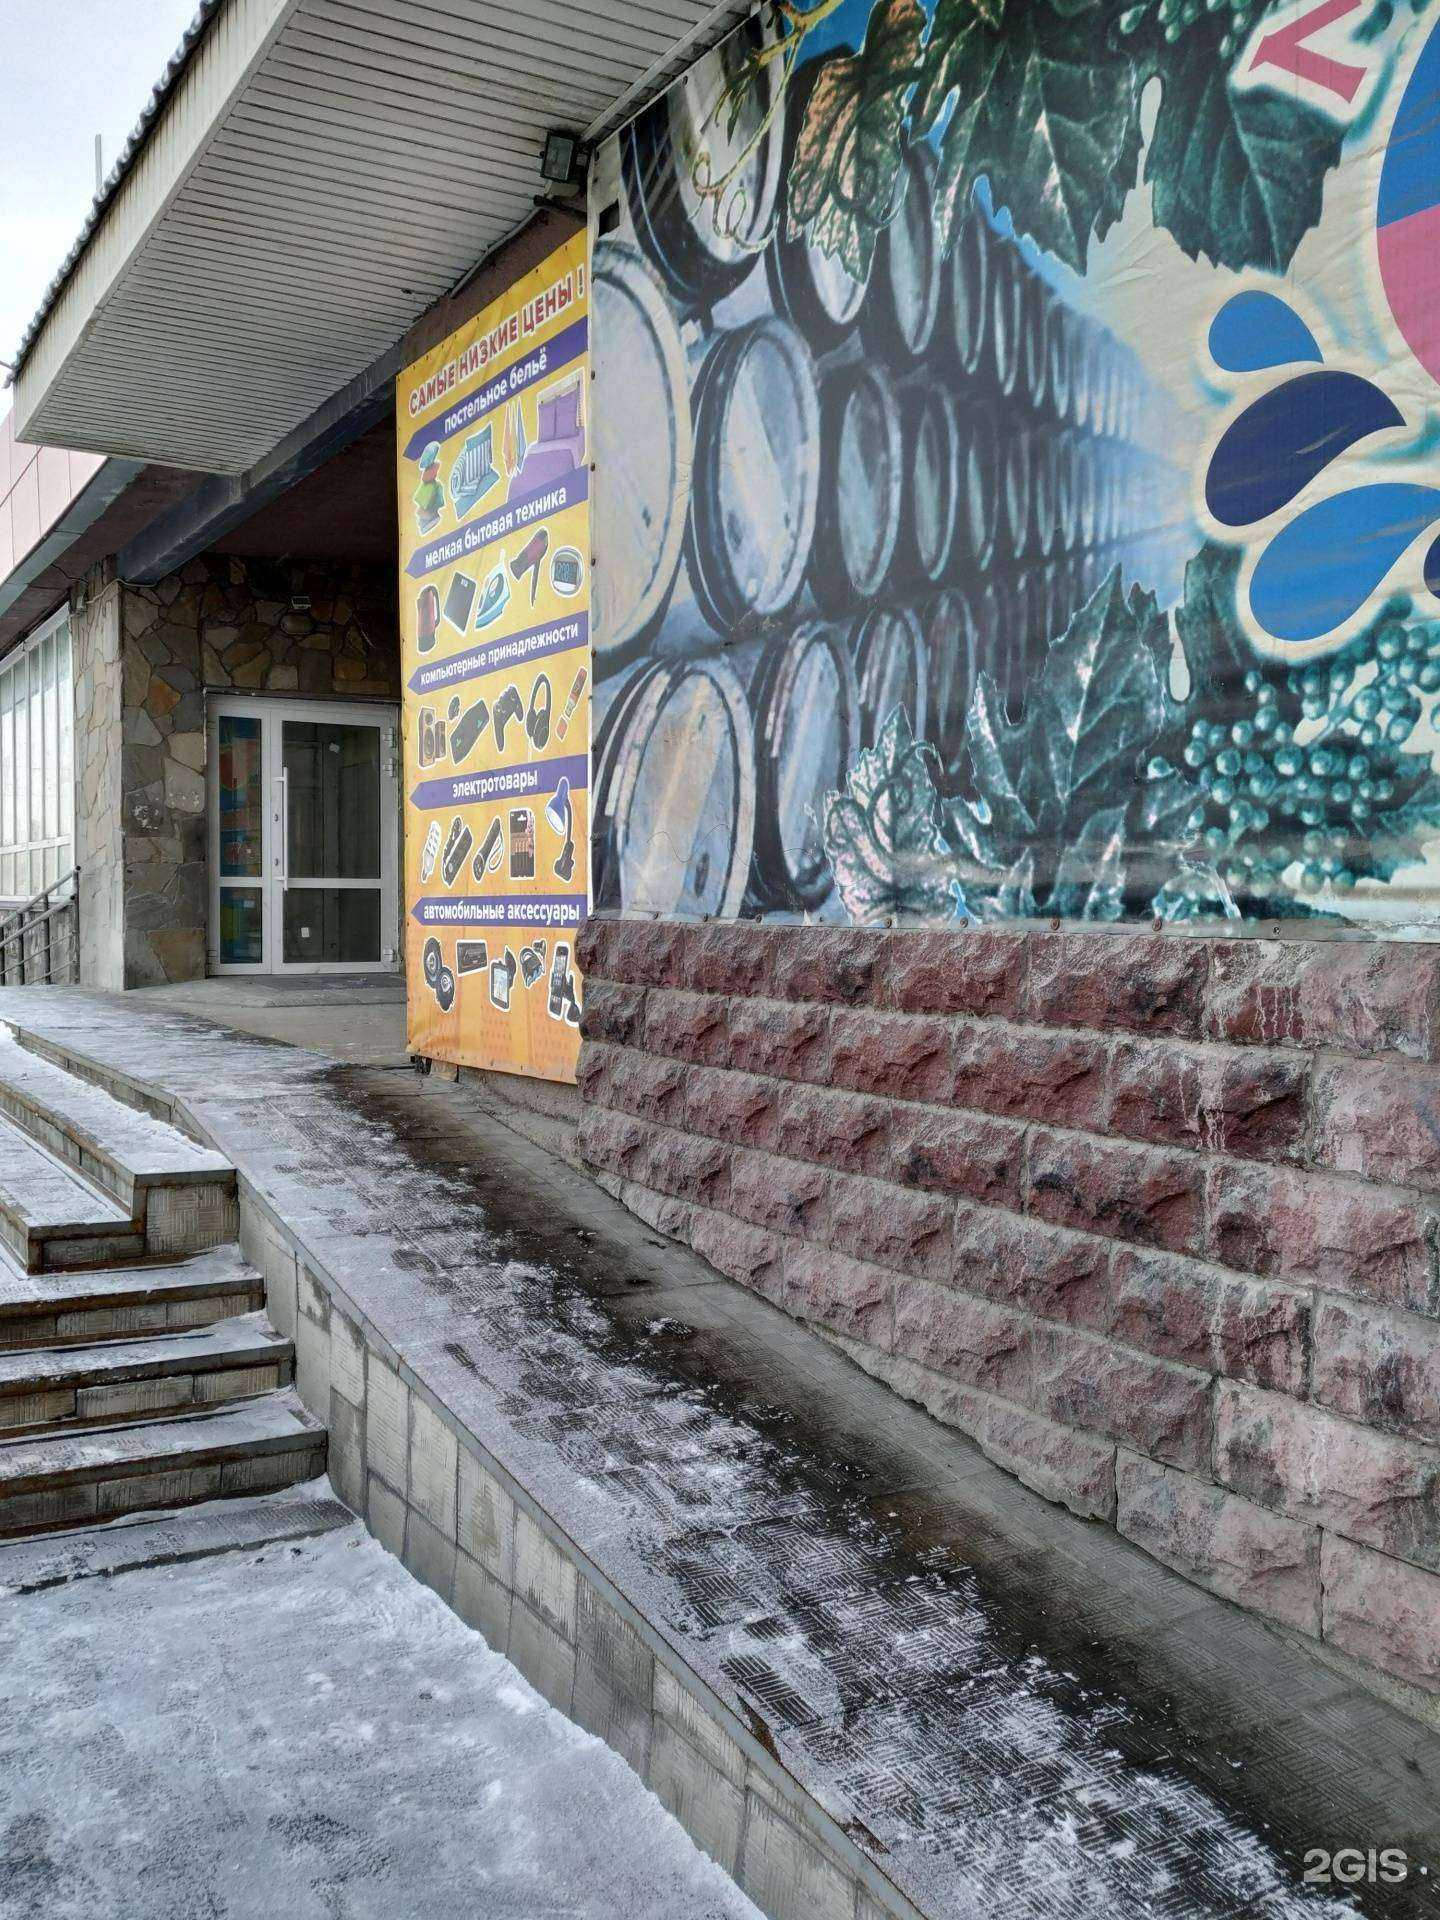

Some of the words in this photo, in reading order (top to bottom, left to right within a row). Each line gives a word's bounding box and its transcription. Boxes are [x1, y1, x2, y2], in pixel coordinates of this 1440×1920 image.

[409, 361, 455, 415] САМЫЕ
[459, 315, 518, 381] НИЗКИЕ
[522, 275, 573, 335] ЦЕНЫ
[444, 383, 507, 433] постельное
[510, 347, 547, 389] бельё
[425, 537, 462, 568] мелкая
[465, 512, 513, 549] бытовая
[516, 487, 566, 523] техника
[420, 652, 486, 686] компьютерные
[488, 623, 578, 666] принадлежности
[453, 770, 538, 798] электротовары
[424, 900, 504, 920] автомобильные
[508, 903, 579, 925] аксессуары
